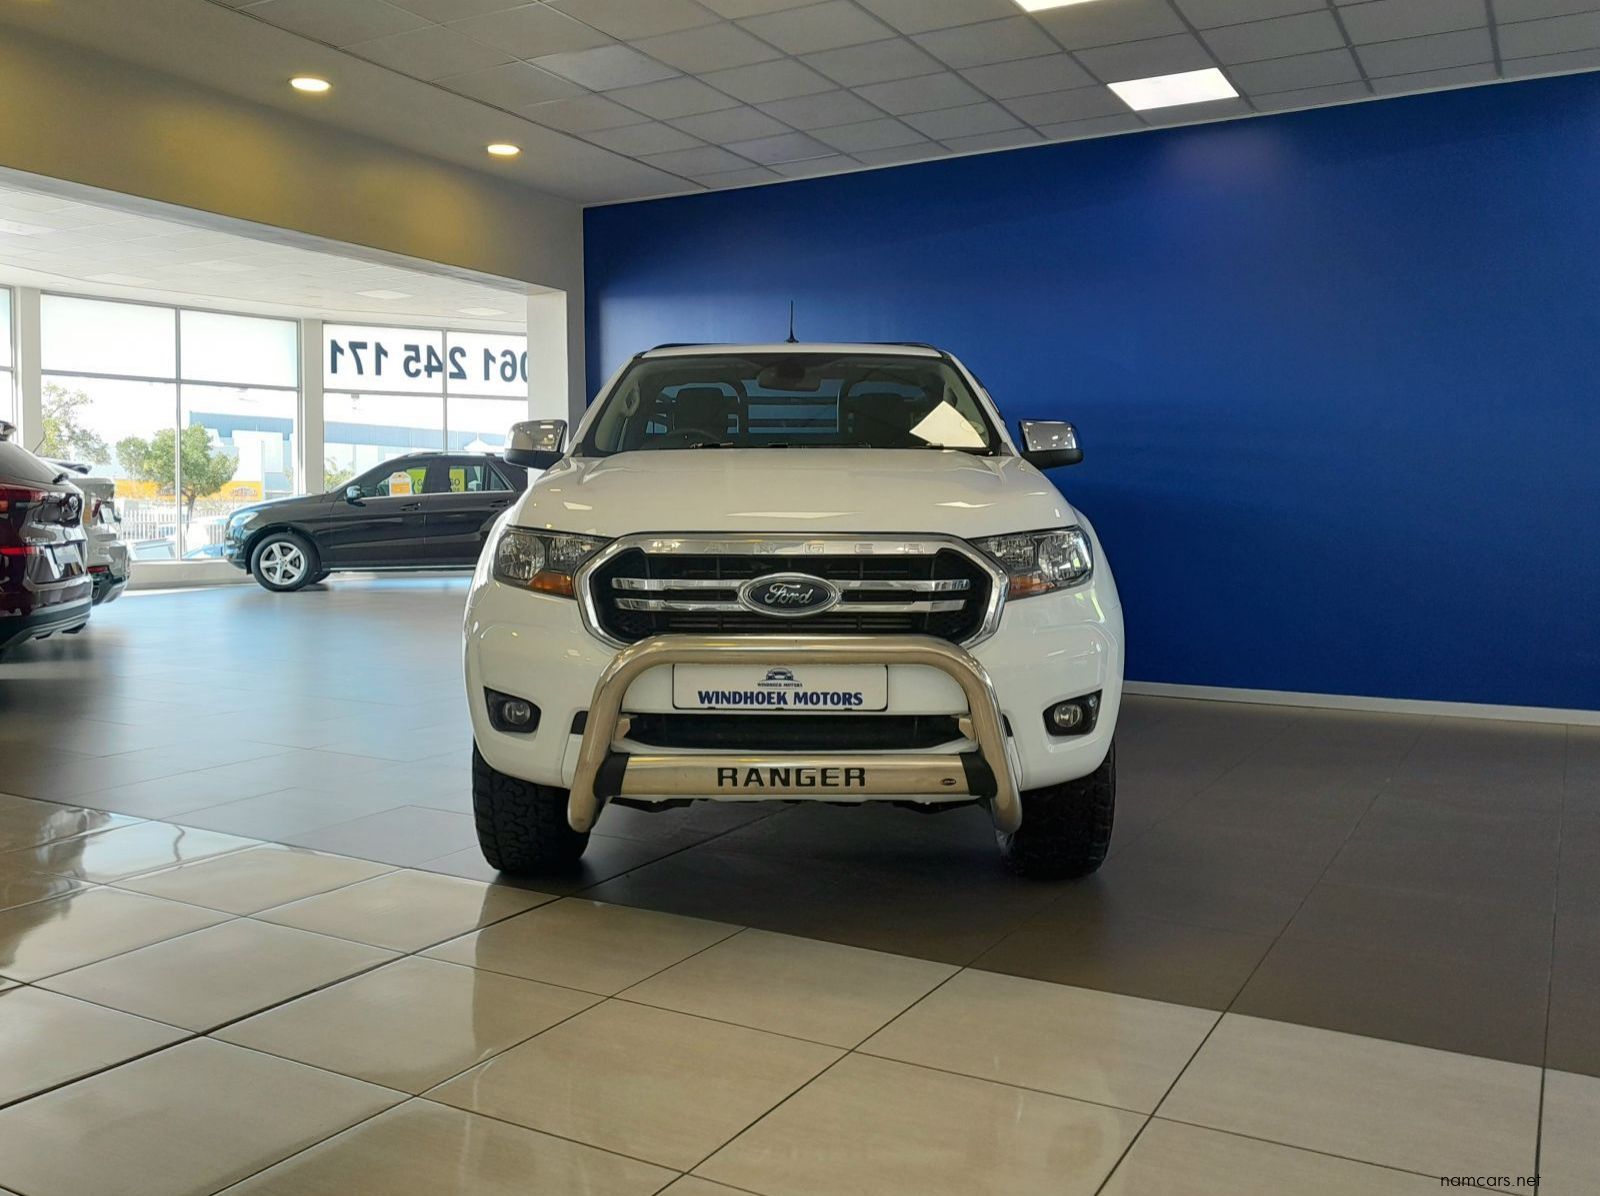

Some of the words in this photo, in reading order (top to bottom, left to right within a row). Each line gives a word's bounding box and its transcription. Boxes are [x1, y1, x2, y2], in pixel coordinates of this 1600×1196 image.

[764, 583, 814, 604] Ford
[698, 690, 789, 705] WINDHOEK
[793, 692, 864, 706] MOTORS
[717, 767, 866, 787] RANGER
